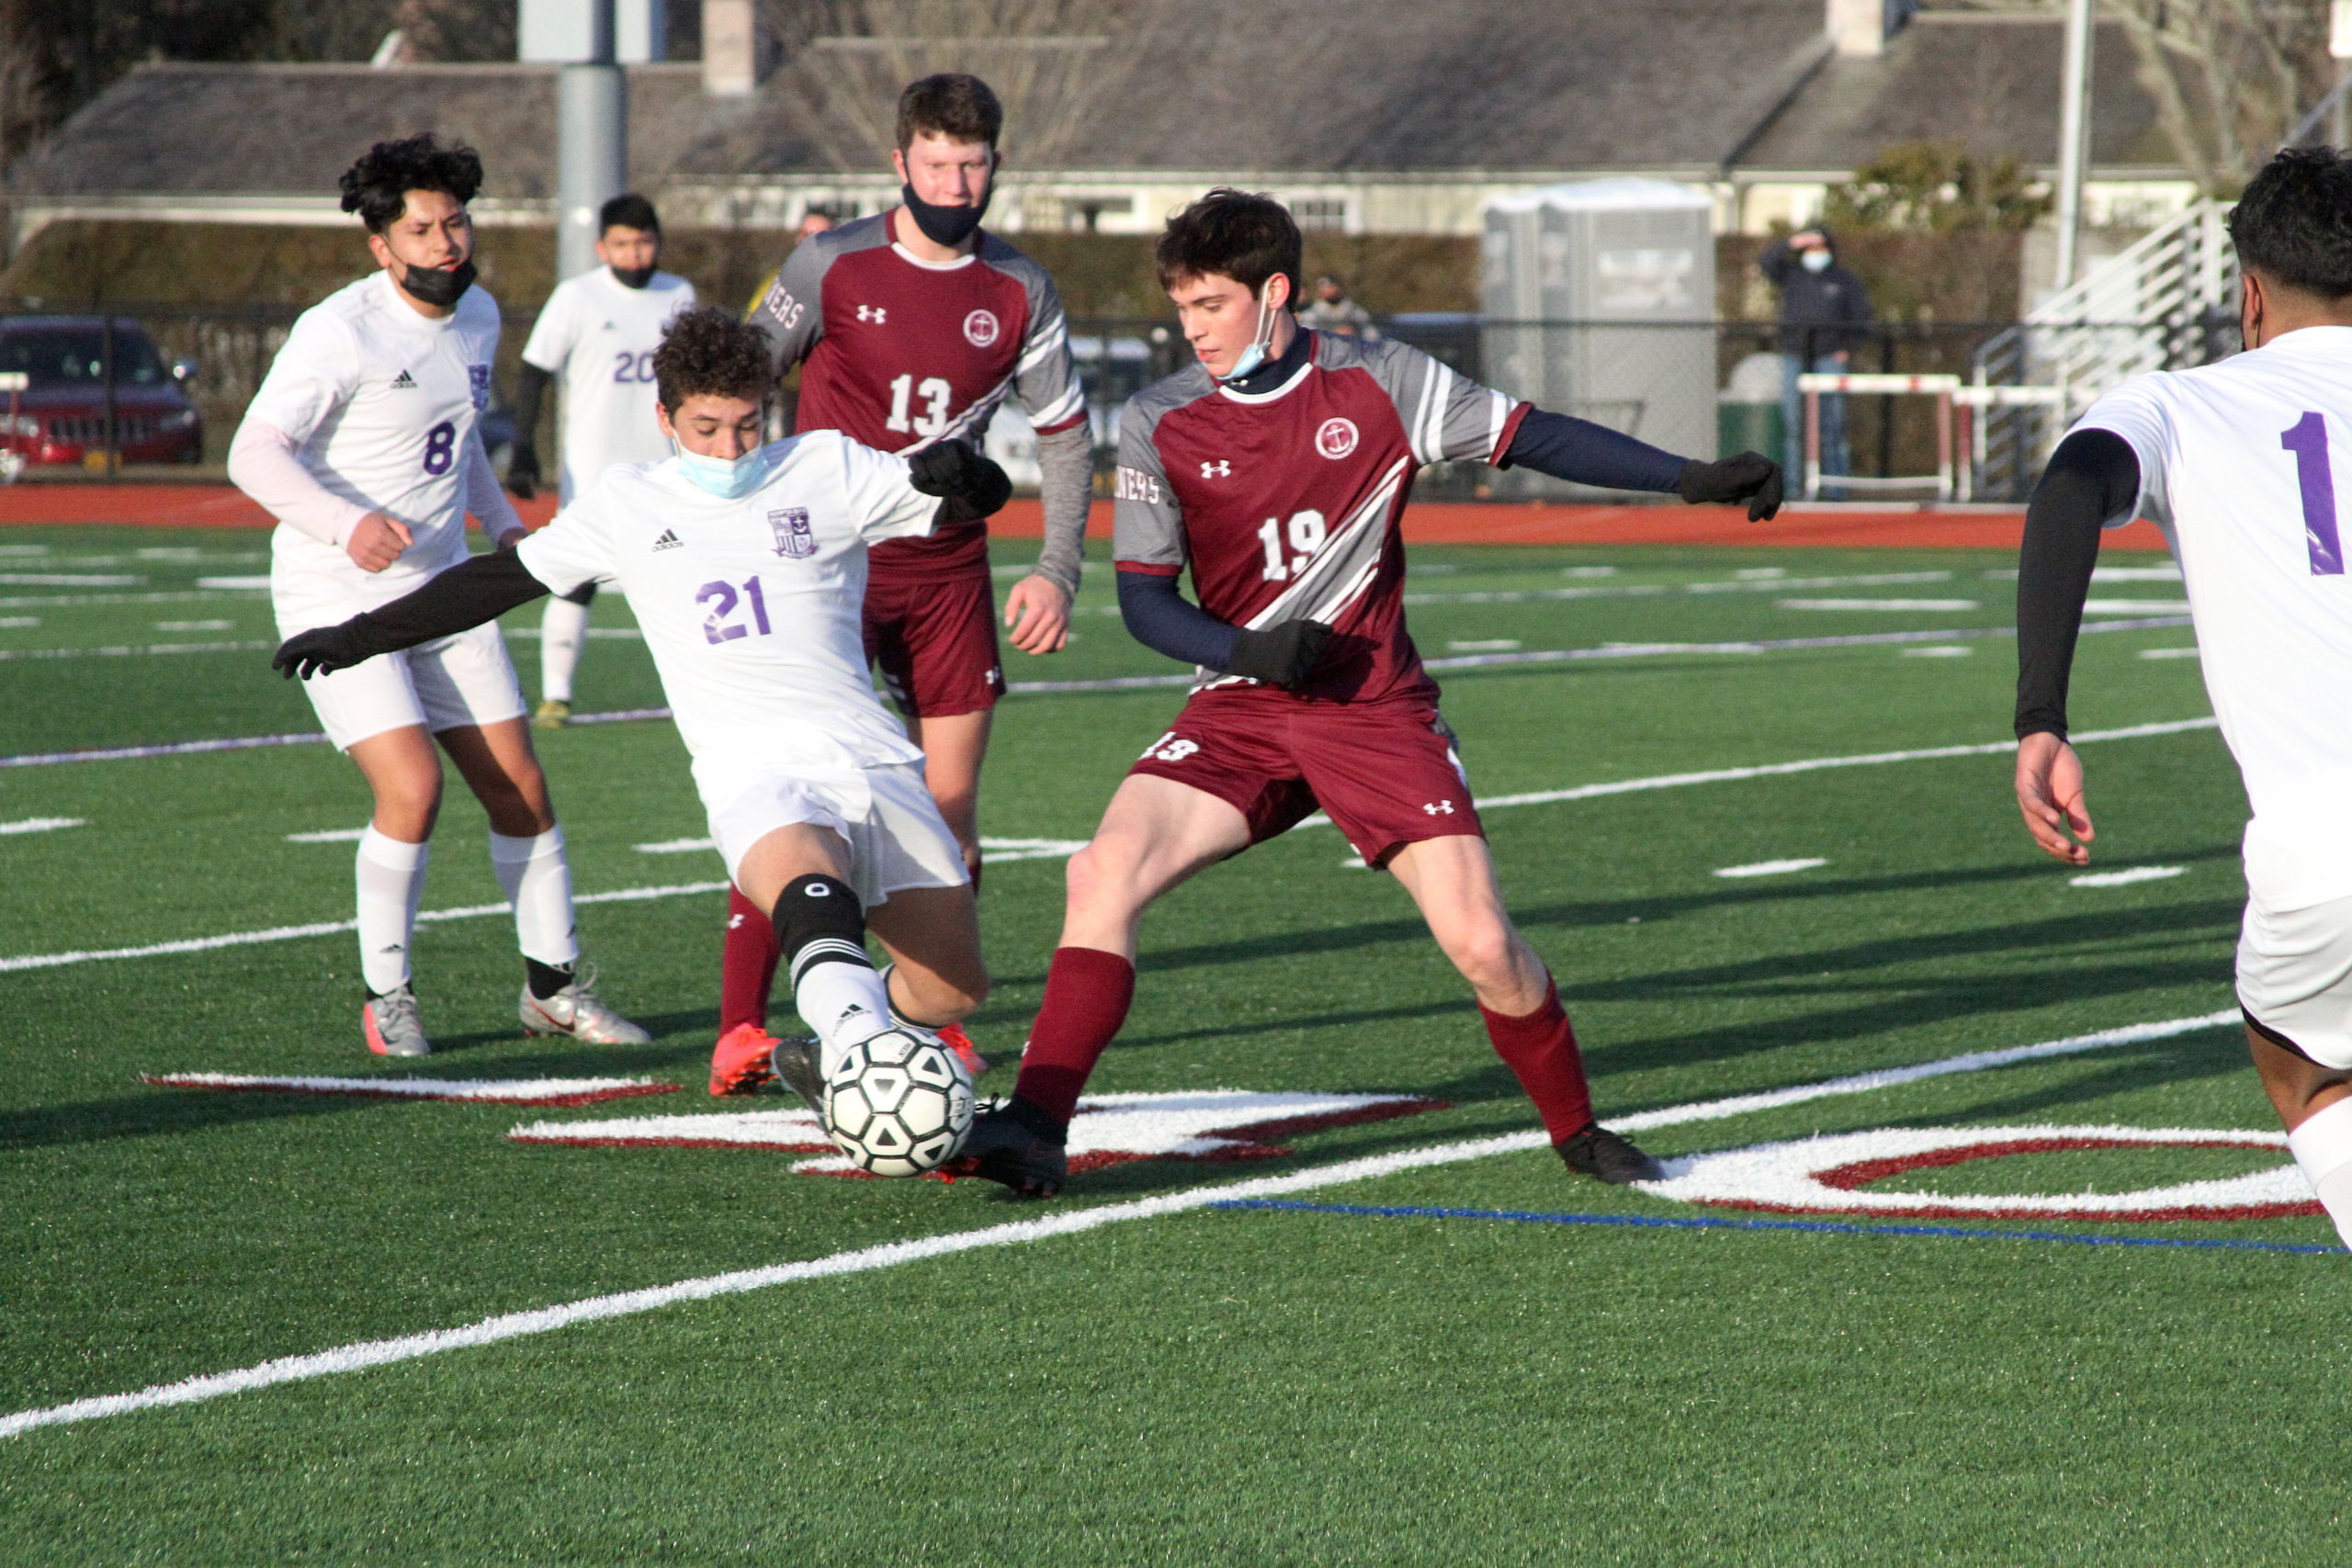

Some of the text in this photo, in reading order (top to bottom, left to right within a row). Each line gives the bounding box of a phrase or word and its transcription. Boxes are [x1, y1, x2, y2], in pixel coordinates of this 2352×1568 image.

[886, 373, 952, 437] 13
[424, 421, 456, 475] 8
[2280, 410, 2345, 575] 1
[1257, 508, 1327, 581] 19
[695, 575, 772, 645] 21
